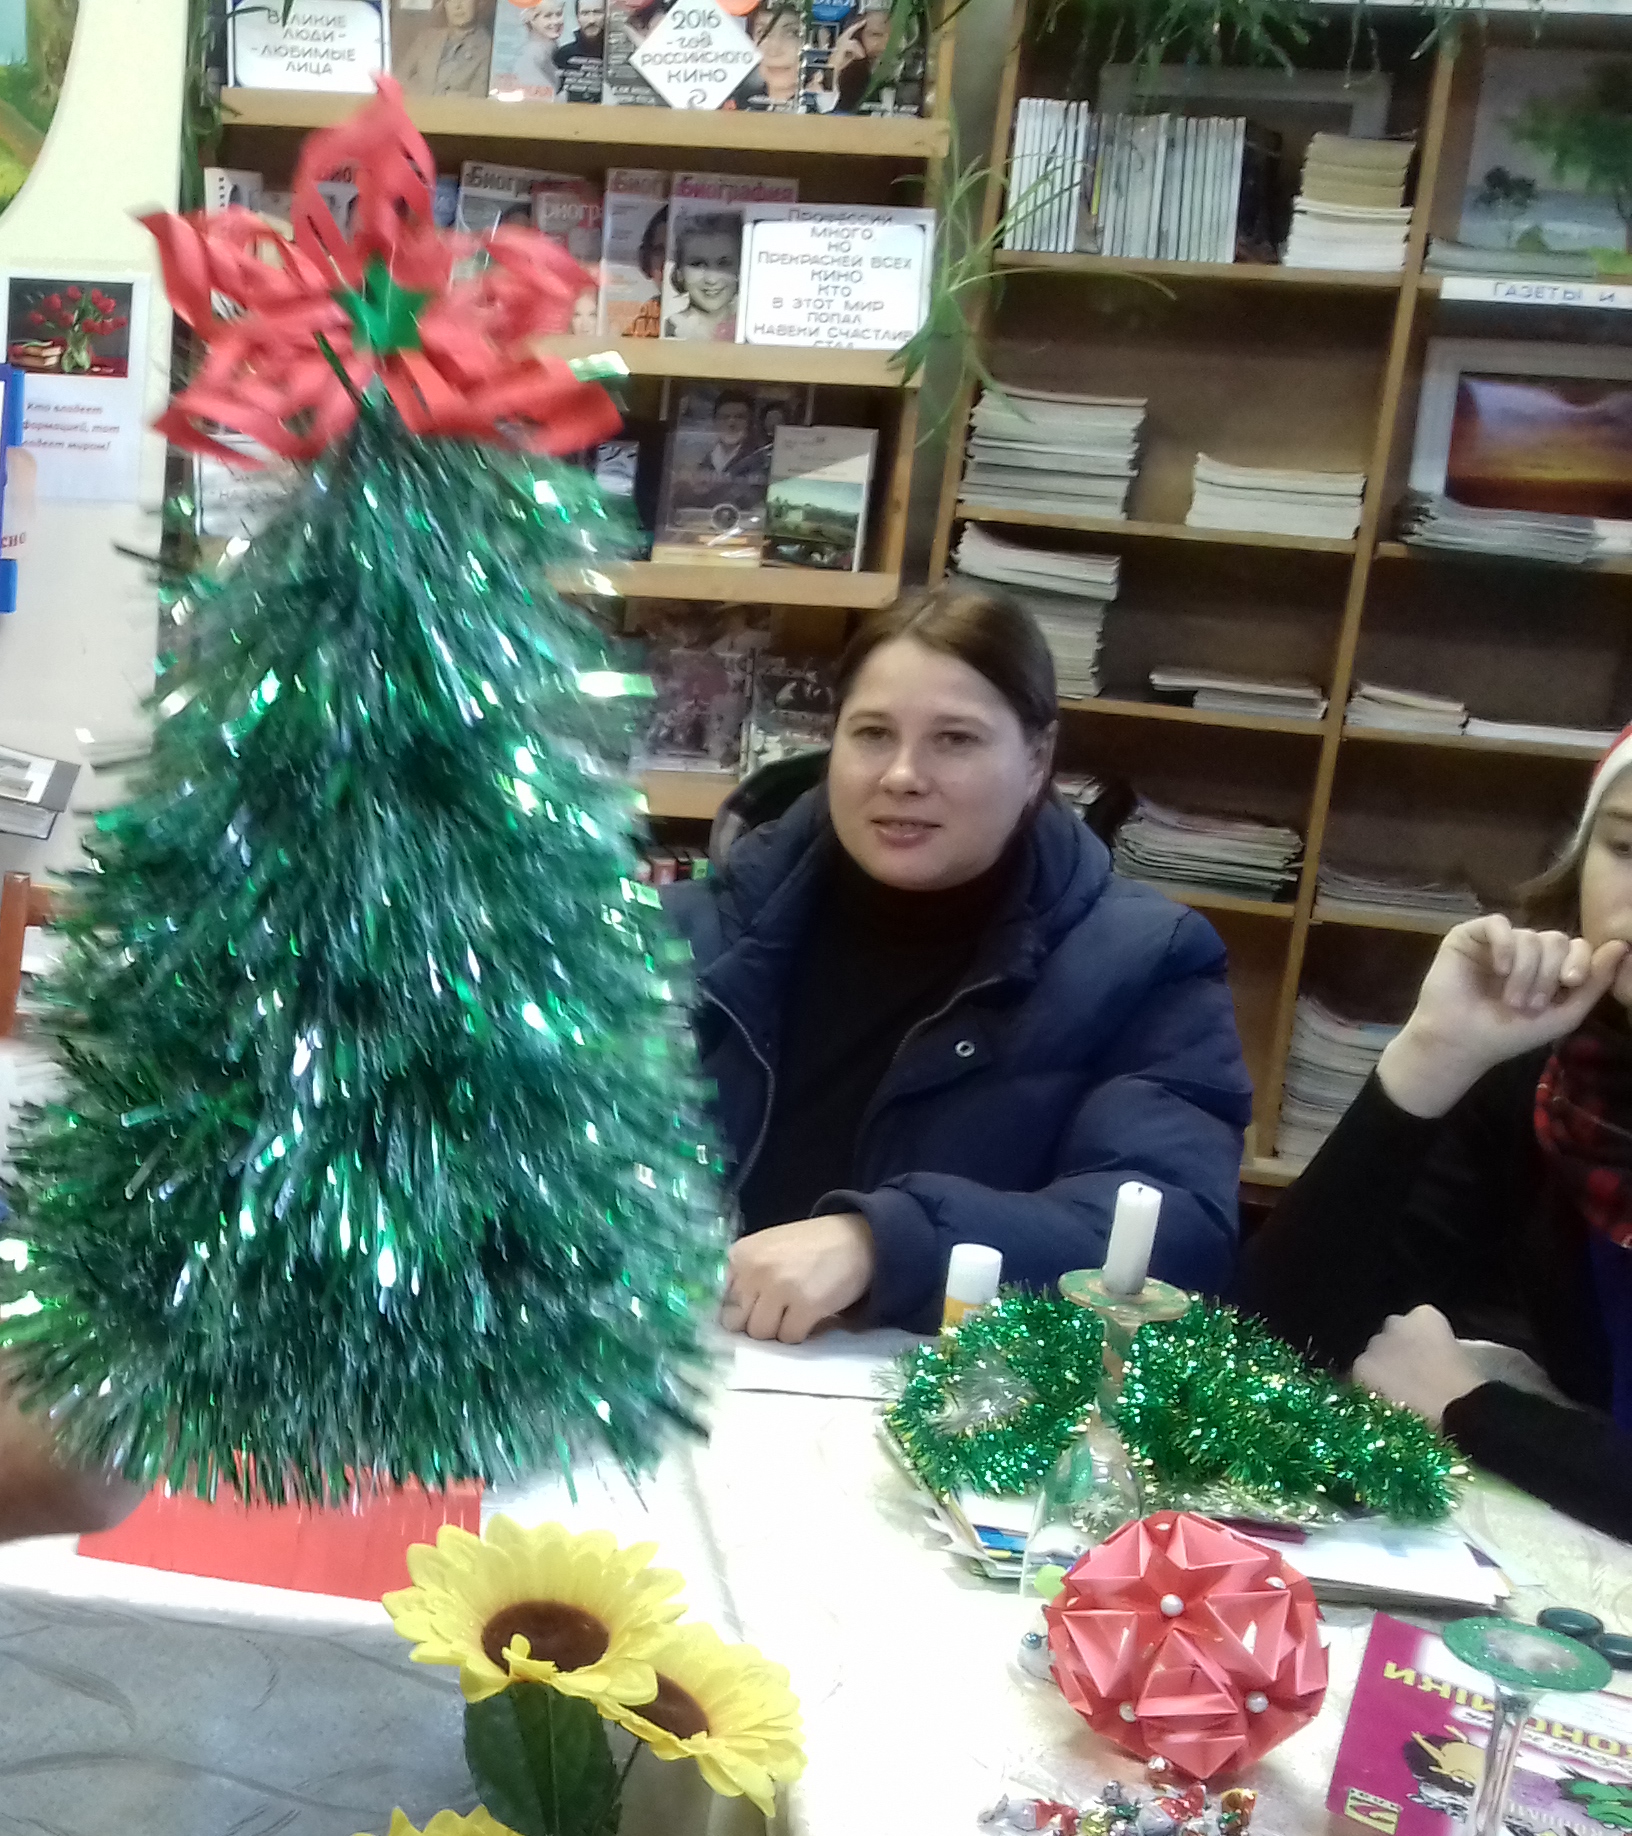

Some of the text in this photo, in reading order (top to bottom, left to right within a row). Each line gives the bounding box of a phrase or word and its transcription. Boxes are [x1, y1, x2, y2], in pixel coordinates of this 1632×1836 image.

[268, 9, 346, 27] ВЛИКИЕ
[672, 9, 722, 30] 2016
[286, 61, 332, 75] ЛИЦА
[667, 68, 727, 83] КИНО
[827, 240, 852, 253] НО
[870, 256, 912, 270] ВСЕХ
[817, 284, 852, 297] КТО
[1493, 282, 1583, 301] ГАЗЕТЫ
[772, 297, 885, 312] В ЭТОТ МИР
